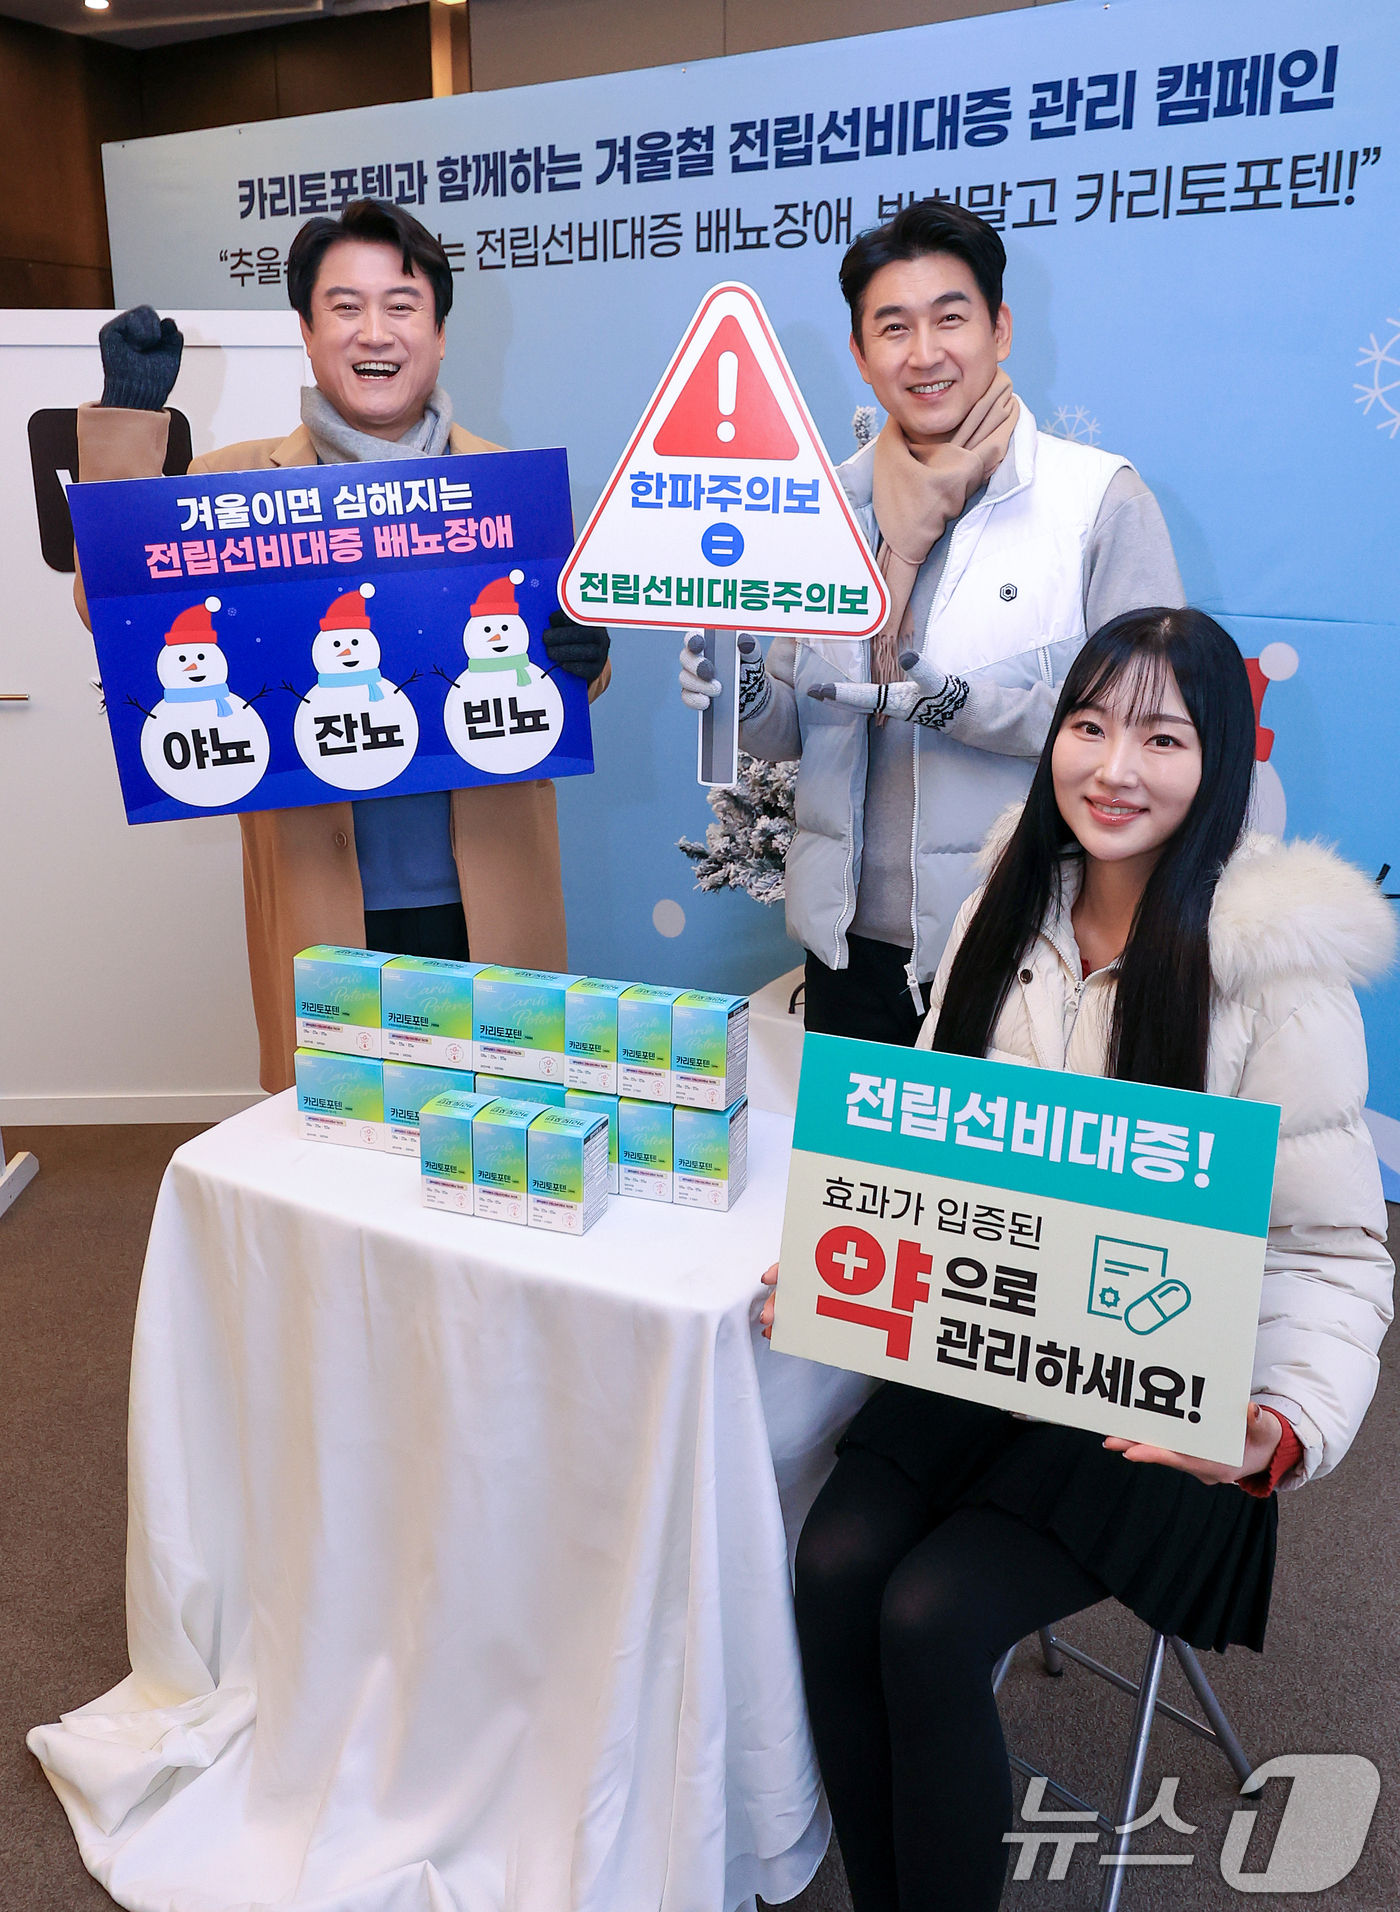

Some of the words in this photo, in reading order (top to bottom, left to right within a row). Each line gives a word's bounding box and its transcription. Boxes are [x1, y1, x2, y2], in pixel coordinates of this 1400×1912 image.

[238, 158, 428, 220] 카리토포텐과
[437, 145, 583, 202] 함께하는
[596, 125, 715, 185] 겨울철
[730, 87, 1012, 173] 전립선비대증
[1029, 70, 1137, 140] 관리
[1157, 45, 1339, 126] 캠페인
[219, 246, 289, 287] “추울
[476, 212, 683, 271] 전립선비대증
[697, 197, 852, 253] 배뇨장애
[1075, 146, 1382, 223] 카리토포텐!”
[629, 471, 820, 514] 한파주의보
[176, 487, 322, 531] 겨울이면
[333, 476, 473, 519] 심해지는
[144, 527, 363, 580] 전립선비대증
[374, 514, 514, 559] 배뇨장애
[579, 572, 869, 615] 전립선비대증주의보
[463, 696, 550, 741] 빈뇨
[313, 711, 405, 757] 잔뇨
[162, 727, 255, 771] 야뇨
[330, 986, 380, 1003] Poten
[301, 1001, 340, 1016] 카리토포텐
[419, 997, 472, 1014] Poten
[388, 1012, 429, 1027] 카리토포텐
[512, 1009, 564, 1027] Poten
[479, 1025, 523, 1040] 카리토포텐
[569, 1041, 602, 1053] 카리토포텐
[622, 1048, 656, 1061] 카리토포텐
[676, 1055, 711, 1068] 카리토포텐
[332, 1082, 383, 1098] Poten
[303, 1096, 343, 1111] 카리토포텐
[390, 1107, 419, 1121] 카리토포
[845, 1072, 1215, 1189] 전립선비대증!
[623, 1150, 657, 1162] 카리토포텐
[425, 1160, 457, 1173] 카리토포텐
[678, 1159, 713, 1171] 카리토포텐
[478, 1170, 511, 1183] 카리토포텐
[532, 1179, 567, 1193] 카리토포텐
[822, 1176, 925, 1227] 효과가
[936, 1198, 1042, 1251] 입증된
[935, 1316, 1206, 1424] 관리하세요!
